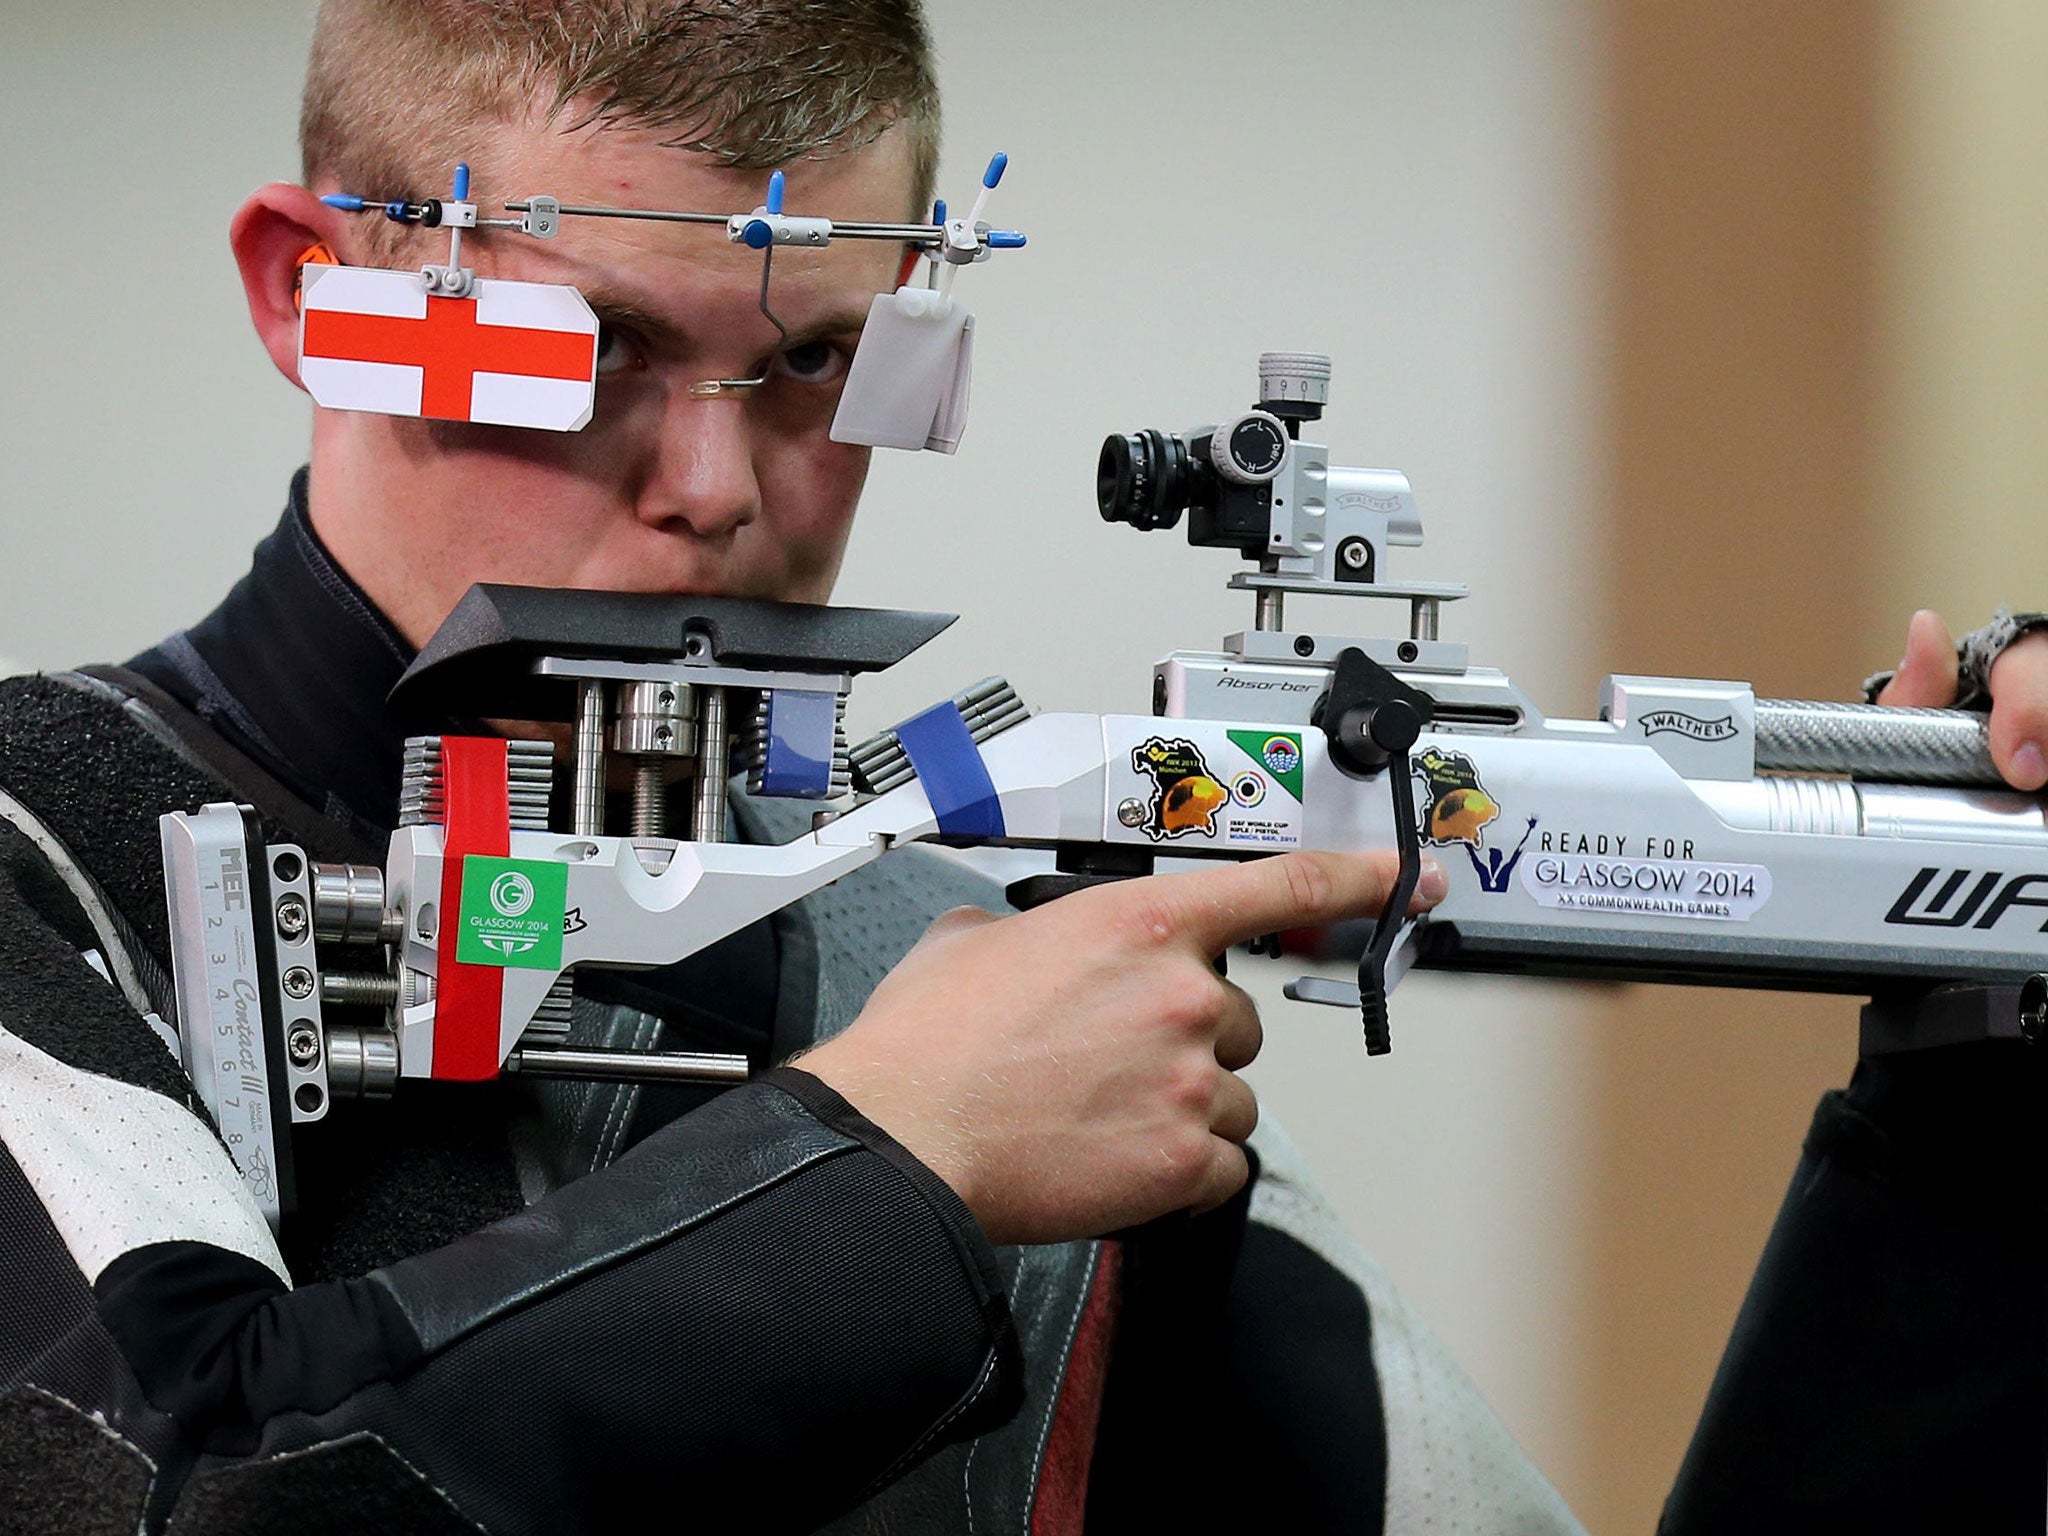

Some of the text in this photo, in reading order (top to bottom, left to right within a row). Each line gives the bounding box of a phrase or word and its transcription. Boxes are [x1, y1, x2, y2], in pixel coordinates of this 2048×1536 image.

[1280, 379, 1288, 391] 9
[1300, 380, 1308, 392] 0
[1257, 420, 1264, 431] L
[1247, 462, 1256, 472] R
[1218, 675, 1319, 693] Absorber
[1652, 716, 1725, 737] WALTHER
[1541, 832, 1695, 859] READY FOR
[219, 847, 246, 913] MEC
[1535, 859, 1756, 898] GLASGOW 2014
[205, 881, 219, 891] 1
[1557, 893, 1730, 916] XX COMMONWEALTH GAMES
[208, 917, 222, 928] 2
[470, 916, 549, 932] GLASGOW 2014
[211, 953, 226, 964] 3
[215, 988, 230, 1000] 4
[218, 1025, 233, 1036] 5
[231, 979, 260, 1072] Contact
[222, 1061, 236, 1072] 6
[225, 1097, 239, 1107] 7
[228, 1133, 243, 1144] 8
